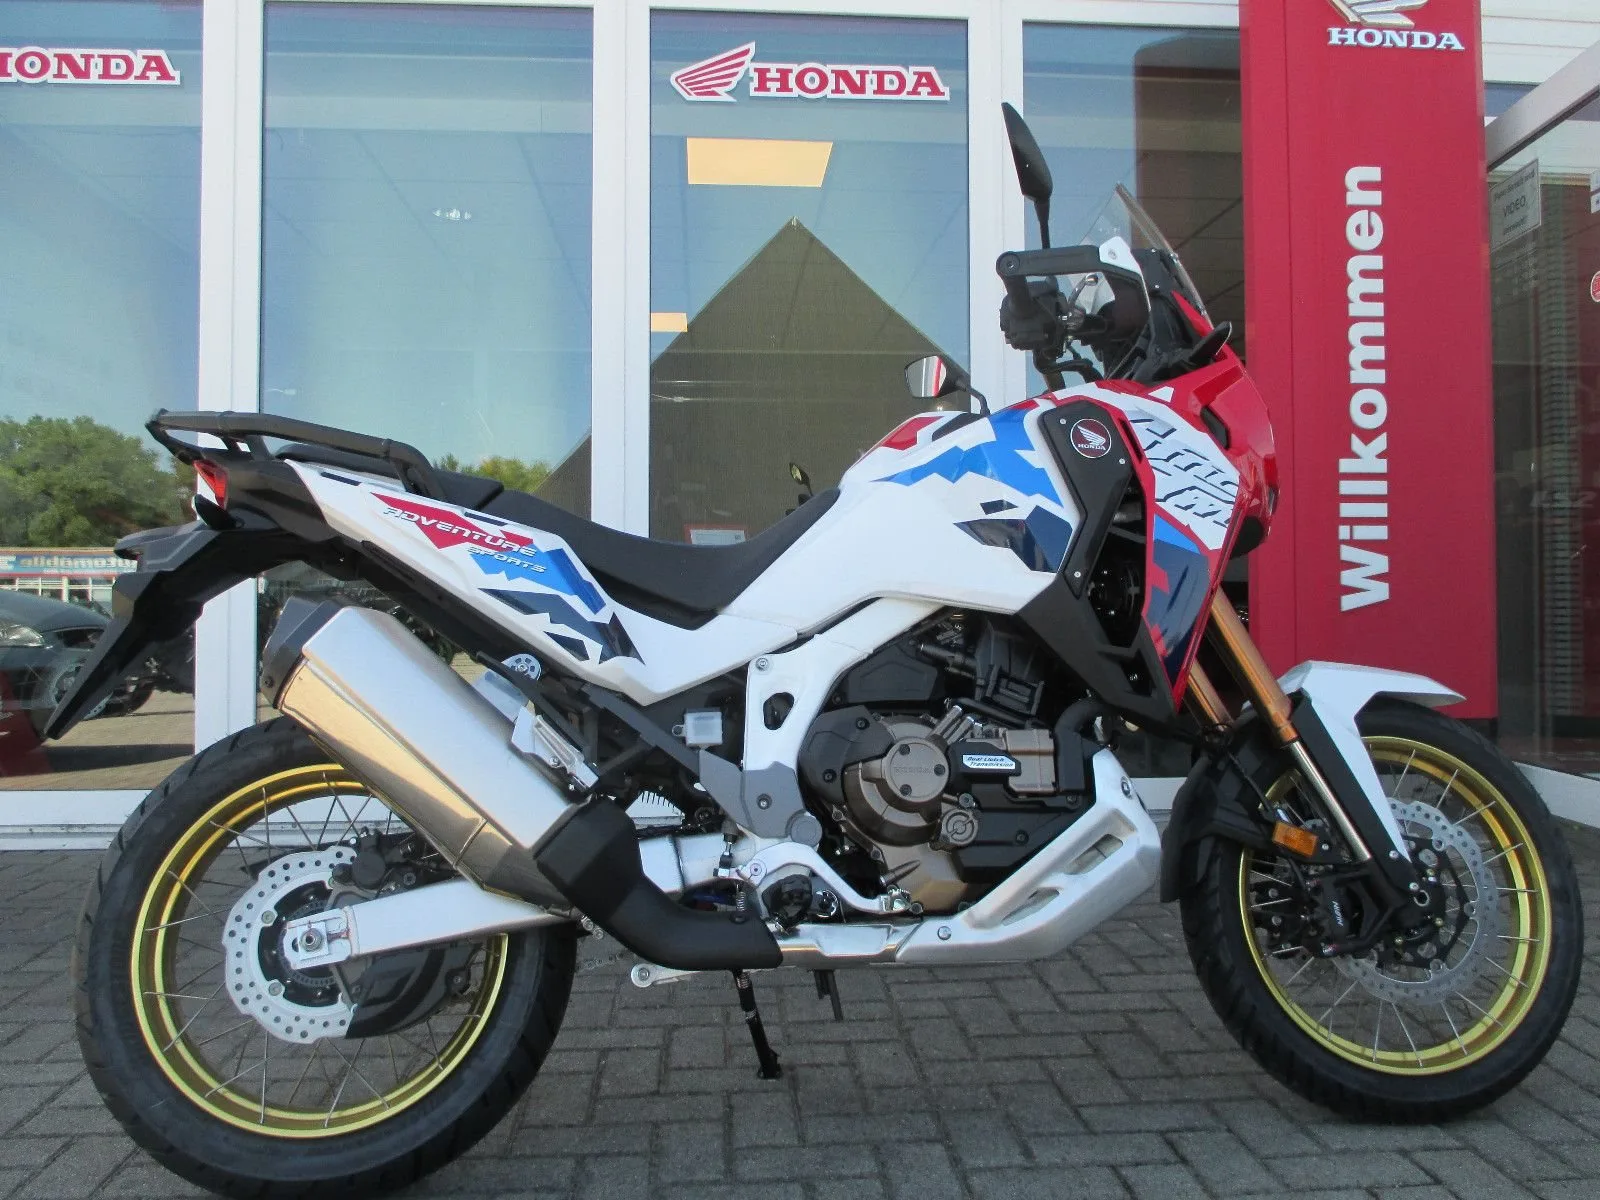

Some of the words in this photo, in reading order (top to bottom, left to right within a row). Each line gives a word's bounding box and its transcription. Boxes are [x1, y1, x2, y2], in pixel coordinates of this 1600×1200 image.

[1327, 27, 1465, 50] HONDA
[753, 66, 946, 97] HONDA
[1503, 195, 1527, 217] VIDEO
[1338, 165, 1390, 613] Willkommen
[383, 506, 537, 558] ADVENTURE
[467, 546, 547, 574] SPORTS
